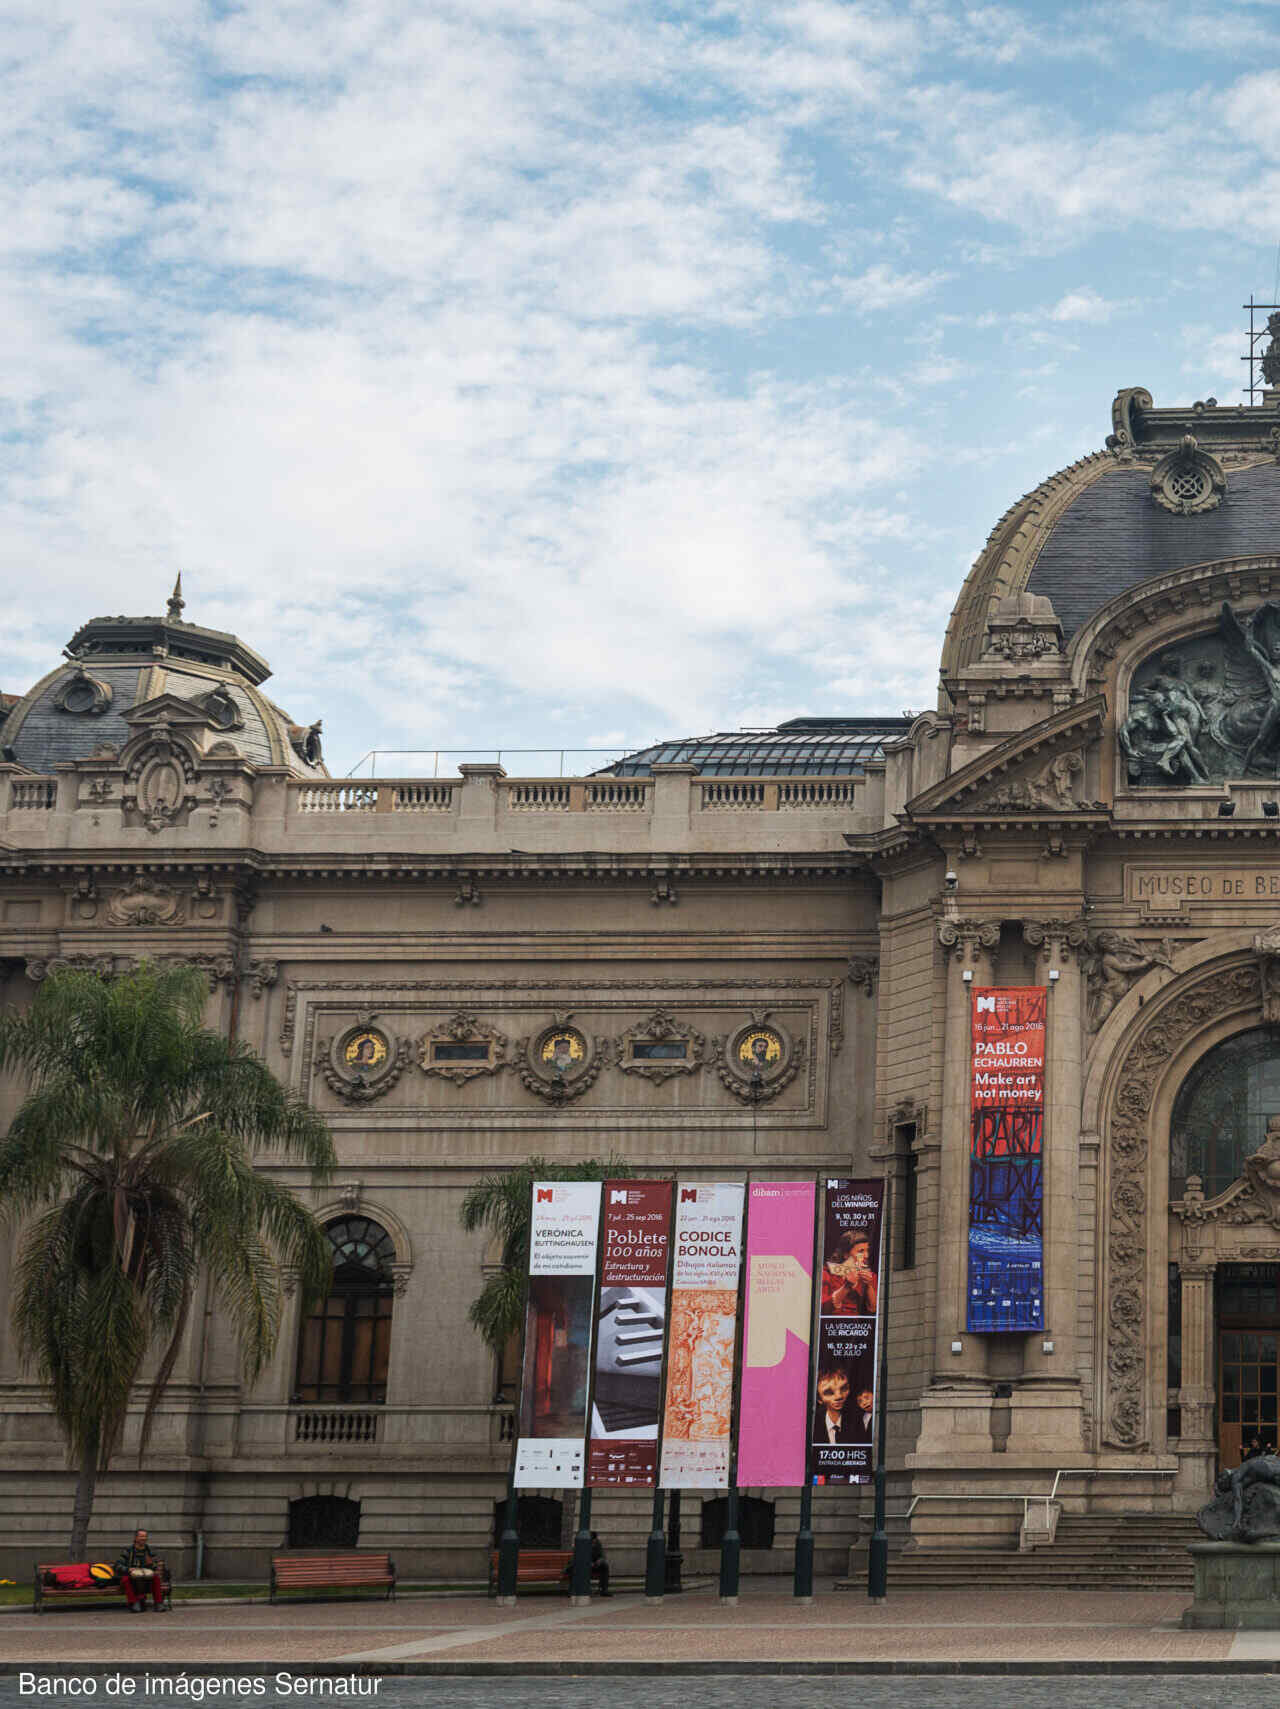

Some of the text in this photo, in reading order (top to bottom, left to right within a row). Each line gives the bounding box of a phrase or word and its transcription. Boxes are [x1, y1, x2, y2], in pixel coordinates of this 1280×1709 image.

[1138, 875, 1213, 895] MUSEO
[1223, 879, 1244, 895] DE
[976, 1042, 1027, 1055] PABLO
[975, 1057, 1042, 1067] ECHAURREN
[976, 1072, 1036, 1084] Make art
[976, 1088, 1041, 1101] not money
[607, 1229, 667, 1244] Poblete
[679, 1231, 732, 1242] CODICE
[606, 1245, 663, 1257] 100 años
[678, 1246, 737, 1256] BONOLA
[820, 1450, 866, 1459] 17:00 HRS
